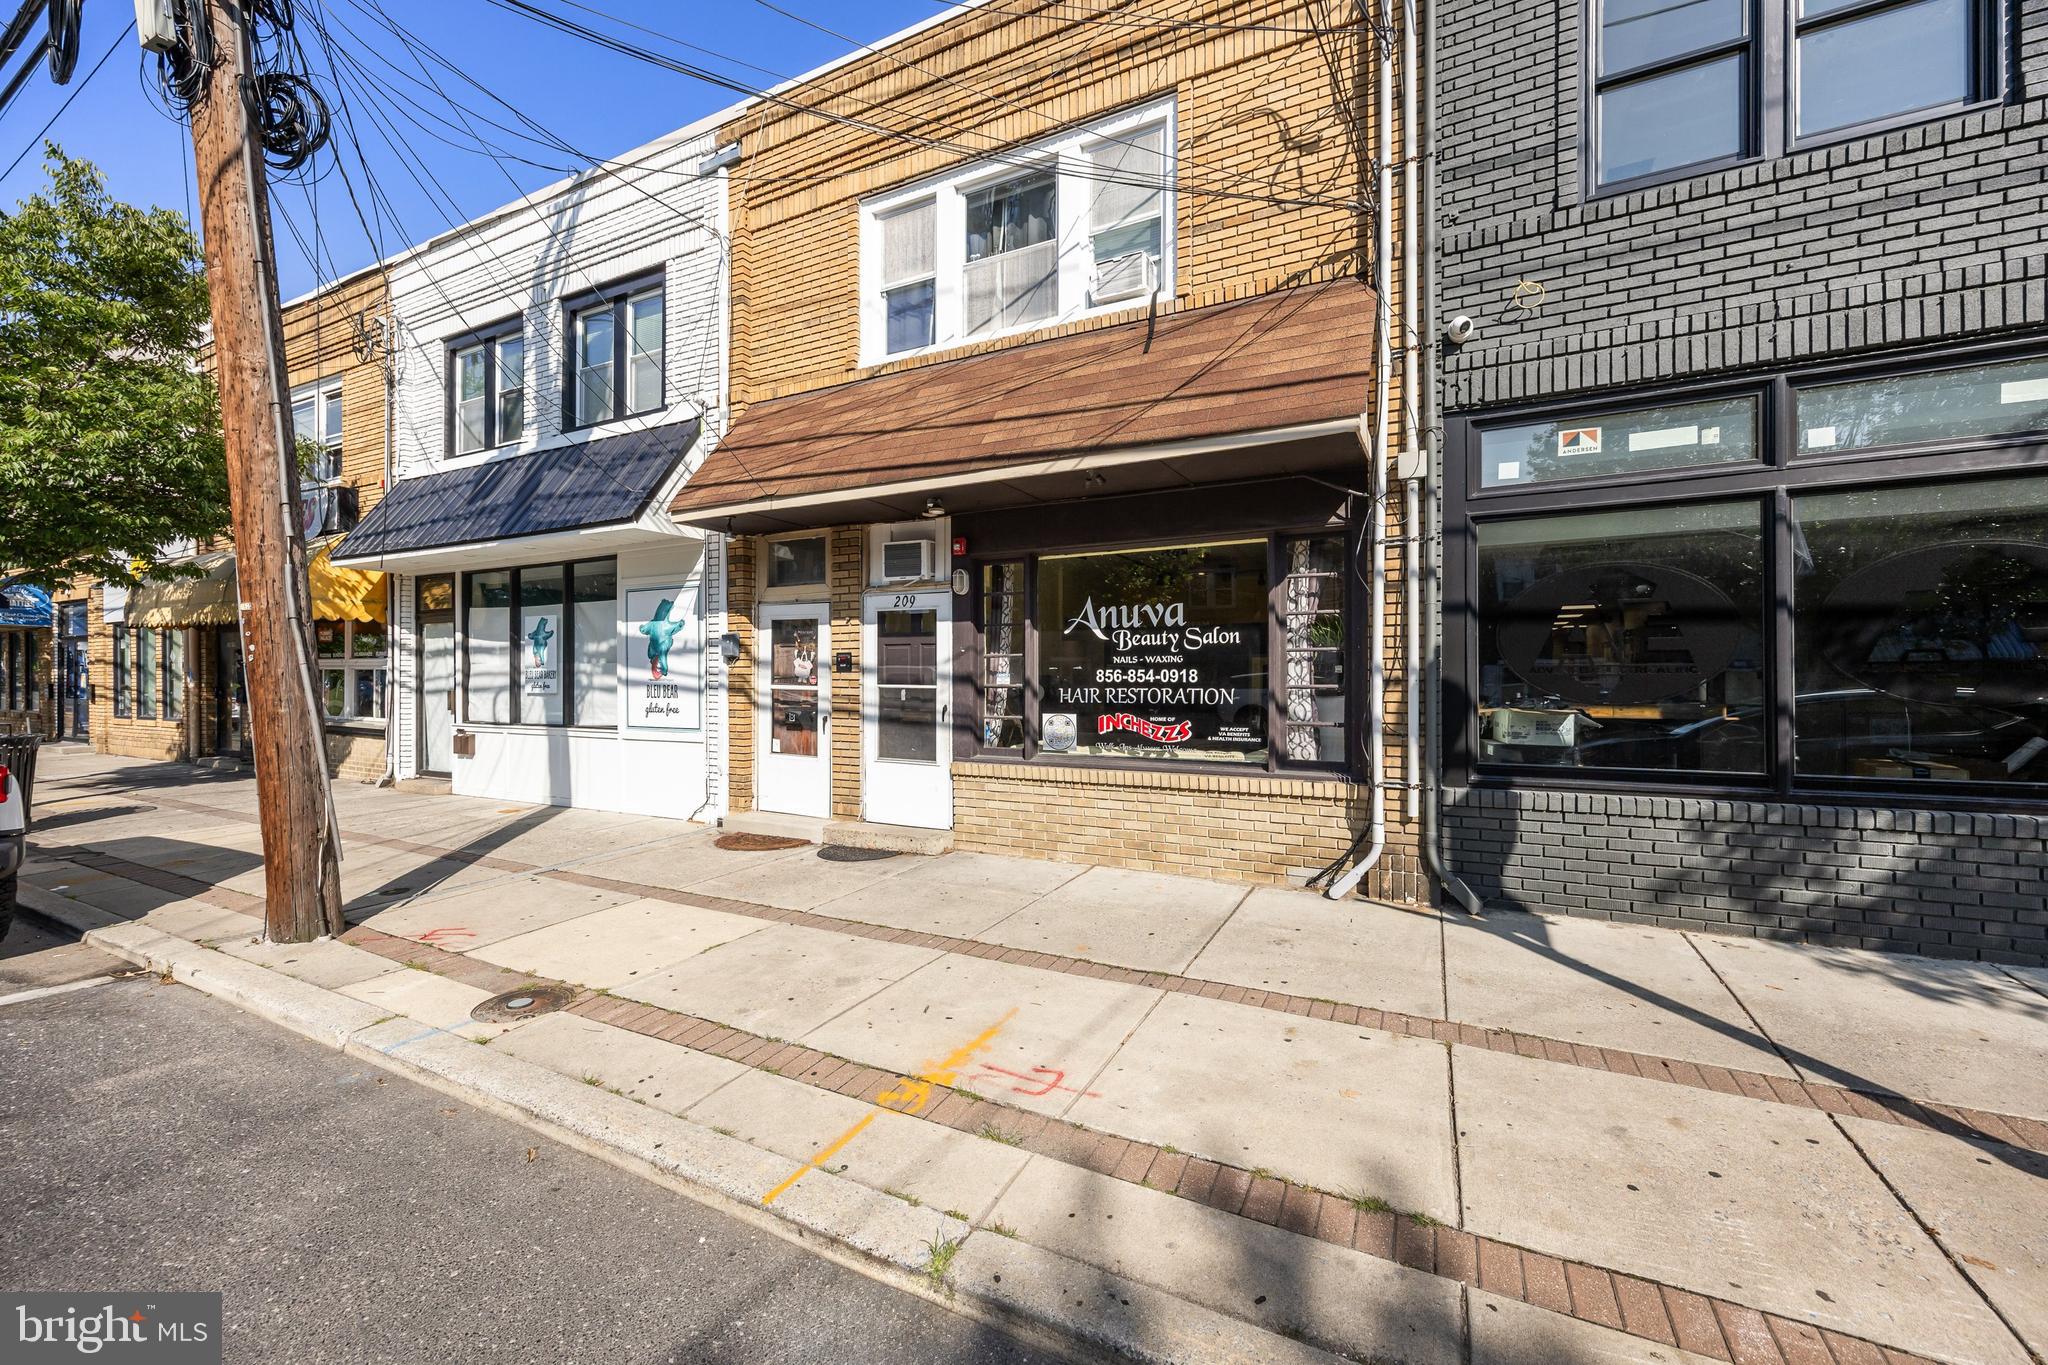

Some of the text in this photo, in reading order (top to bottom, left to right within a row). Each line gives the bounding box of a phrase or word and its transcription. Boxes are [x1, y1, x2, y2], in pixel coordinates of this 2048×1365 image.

[1562, 446, 1598, 455] ANDERSEN
[893, 594, 916, 609] 209
[1063, 595, 1187, 640] Anuva
[1112, 626, 1241, 652] Beauty Salon
[1113, 655, 1138, 664] NAILS
[1145, 655, 1184, 663] WAXING
[1095, 668, 1199, 683] 856-854-0918
[646, 684, 679, 699] BLEU BEAR
[1058, 687, 1235, 705] HAIR RESTORATION
[645, 702, 680, 718] gluten free
[1097, 712, 1193, 743] INCHEZZS
